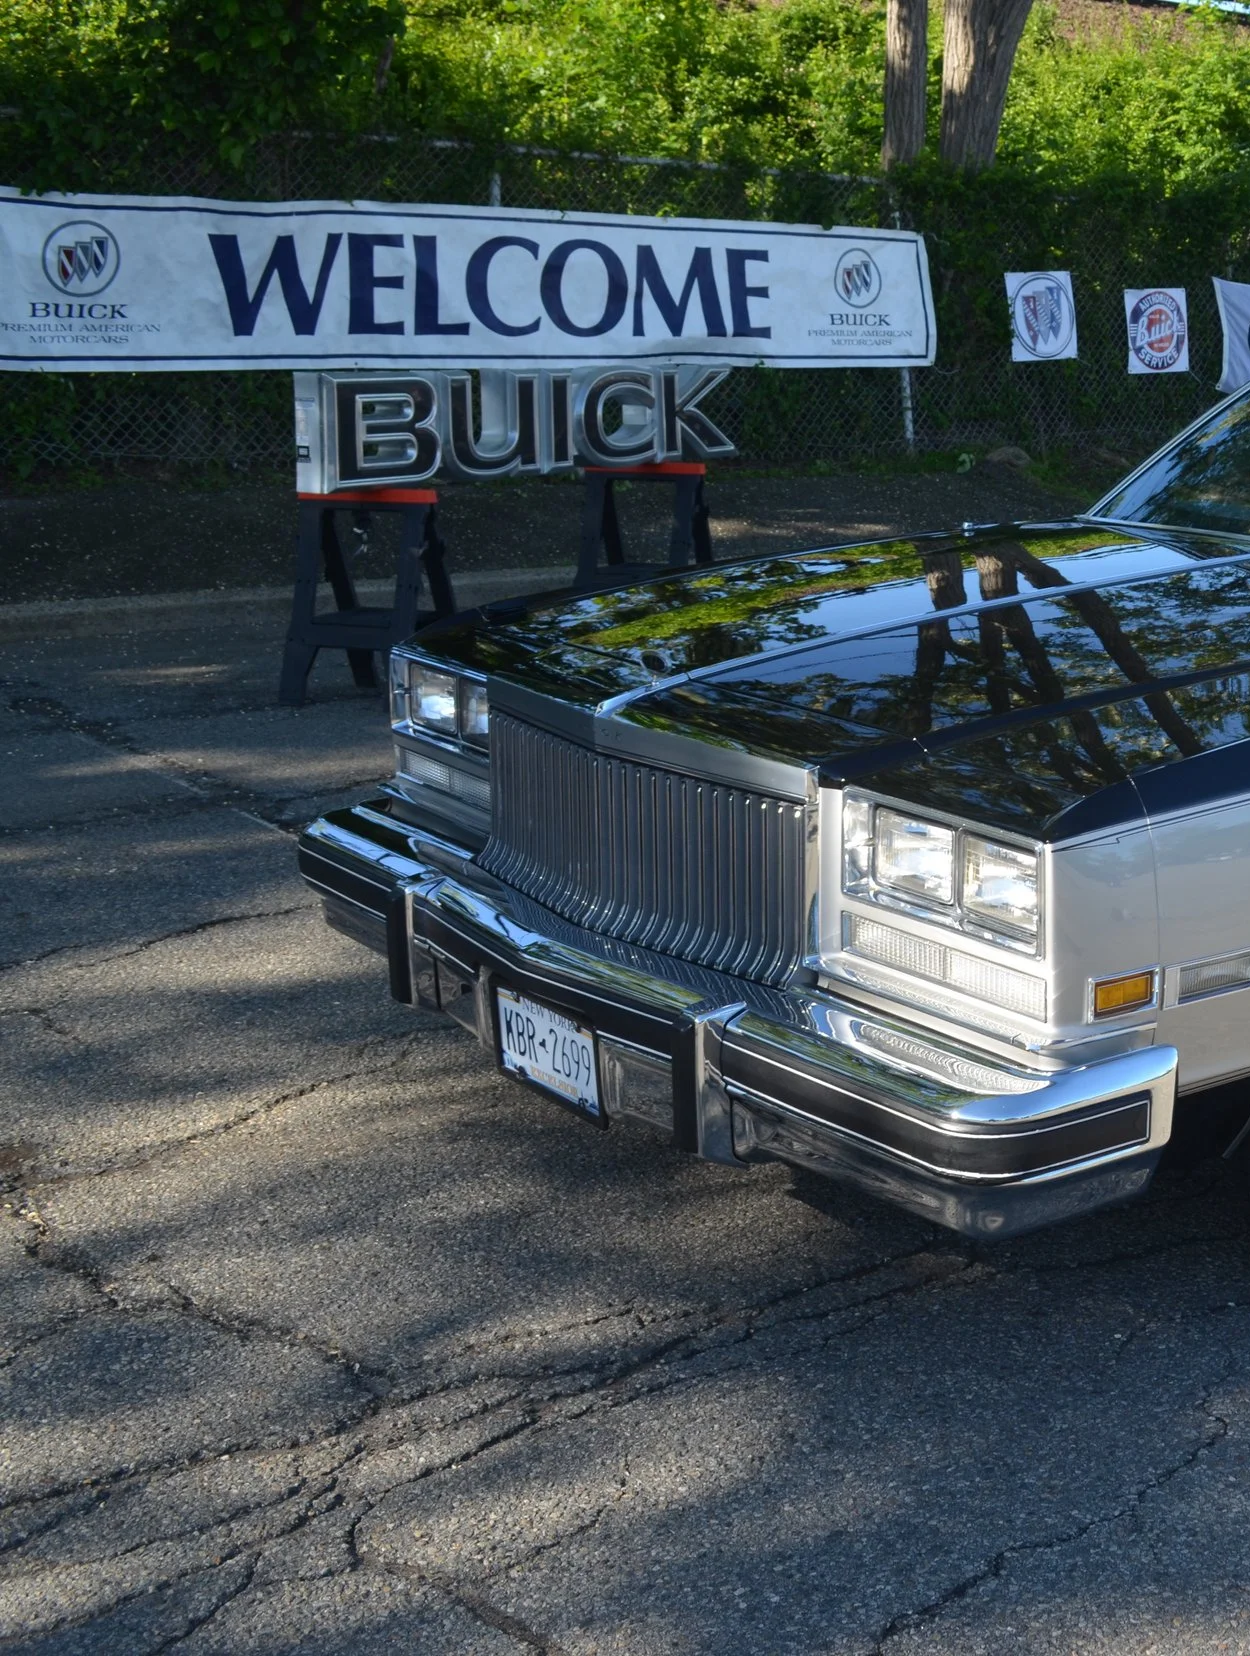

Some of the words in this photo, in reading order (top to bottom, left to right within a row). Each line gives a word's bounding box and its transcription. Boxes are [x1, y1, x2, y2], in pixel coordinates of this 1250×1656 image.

[208, 233, 771, 339] WELCOME
[30, 302, 129, 320] BUICK
[829, 313, 891, 327] BUICK
[79, 323, 161, 333] AMERICAN
[29, 334, 129, 344] MOTORCARS
[1138, 347, 1179, 368] SERVICE
[321, 360, 738, 494] BUICK
[522, 998, 544, 1019] NEW
